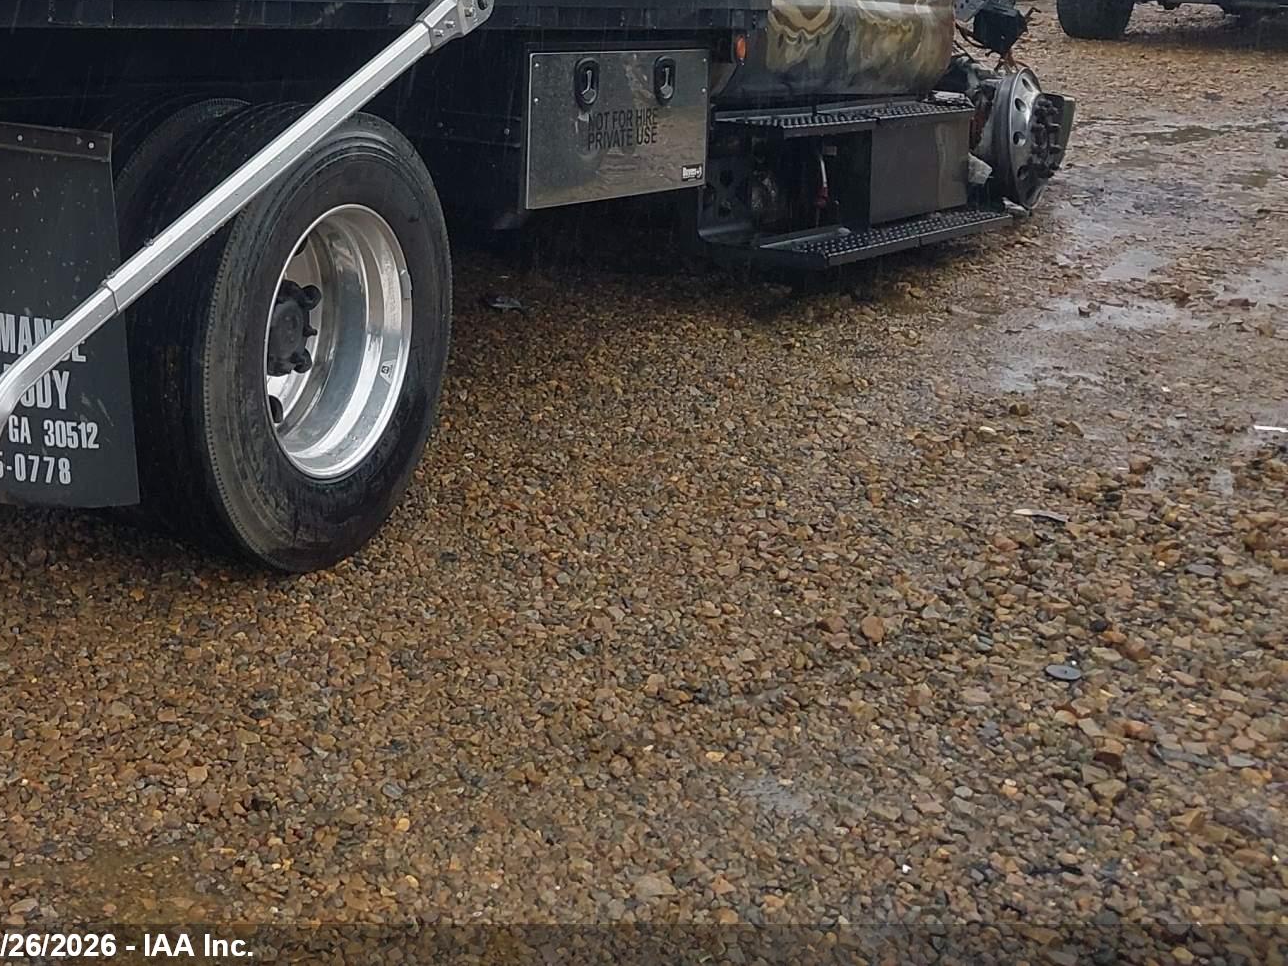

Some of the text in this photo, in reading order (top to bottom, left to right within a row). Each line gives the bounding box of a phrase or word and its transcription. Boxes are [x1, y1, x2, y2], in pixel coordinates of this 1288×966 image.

[588, 107, 658, 131] NOT FOR HIRE
[588, 126, 658, 150] PRIVATE USE
[2, 363, 70, 411] DY
[8, 415, 32, 445] GA
[43, 419, 100, 449] 30512
